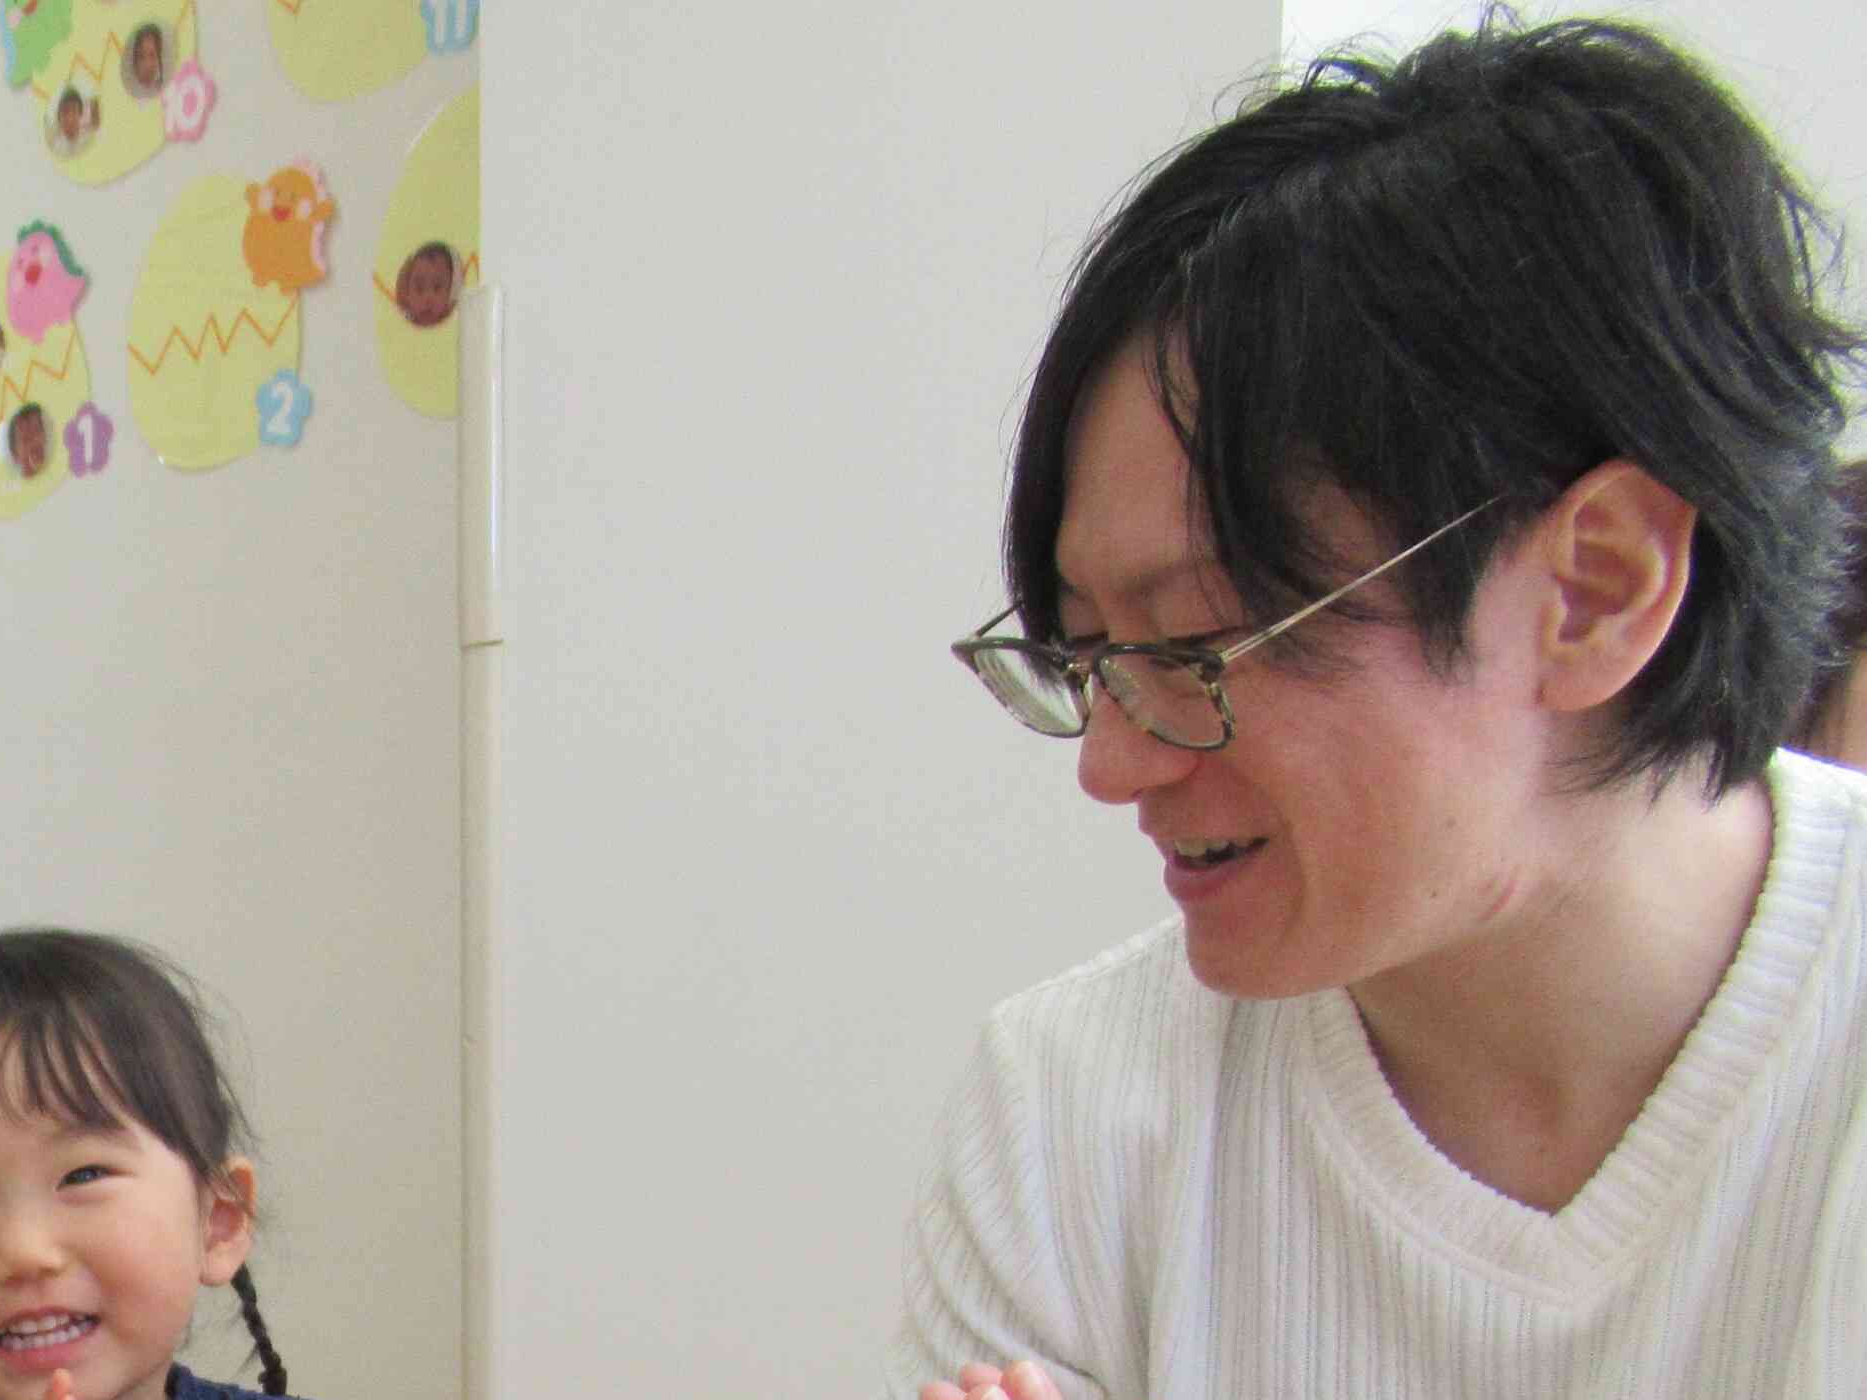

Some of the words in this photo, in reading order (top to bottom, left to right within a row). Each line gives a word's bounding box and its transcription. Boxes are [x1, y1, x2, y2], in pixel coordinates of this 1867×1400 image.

[162, 74, 206, 130] 10
[266, 381, 294, 433] 2
[76, 414, 93, 465] 1
